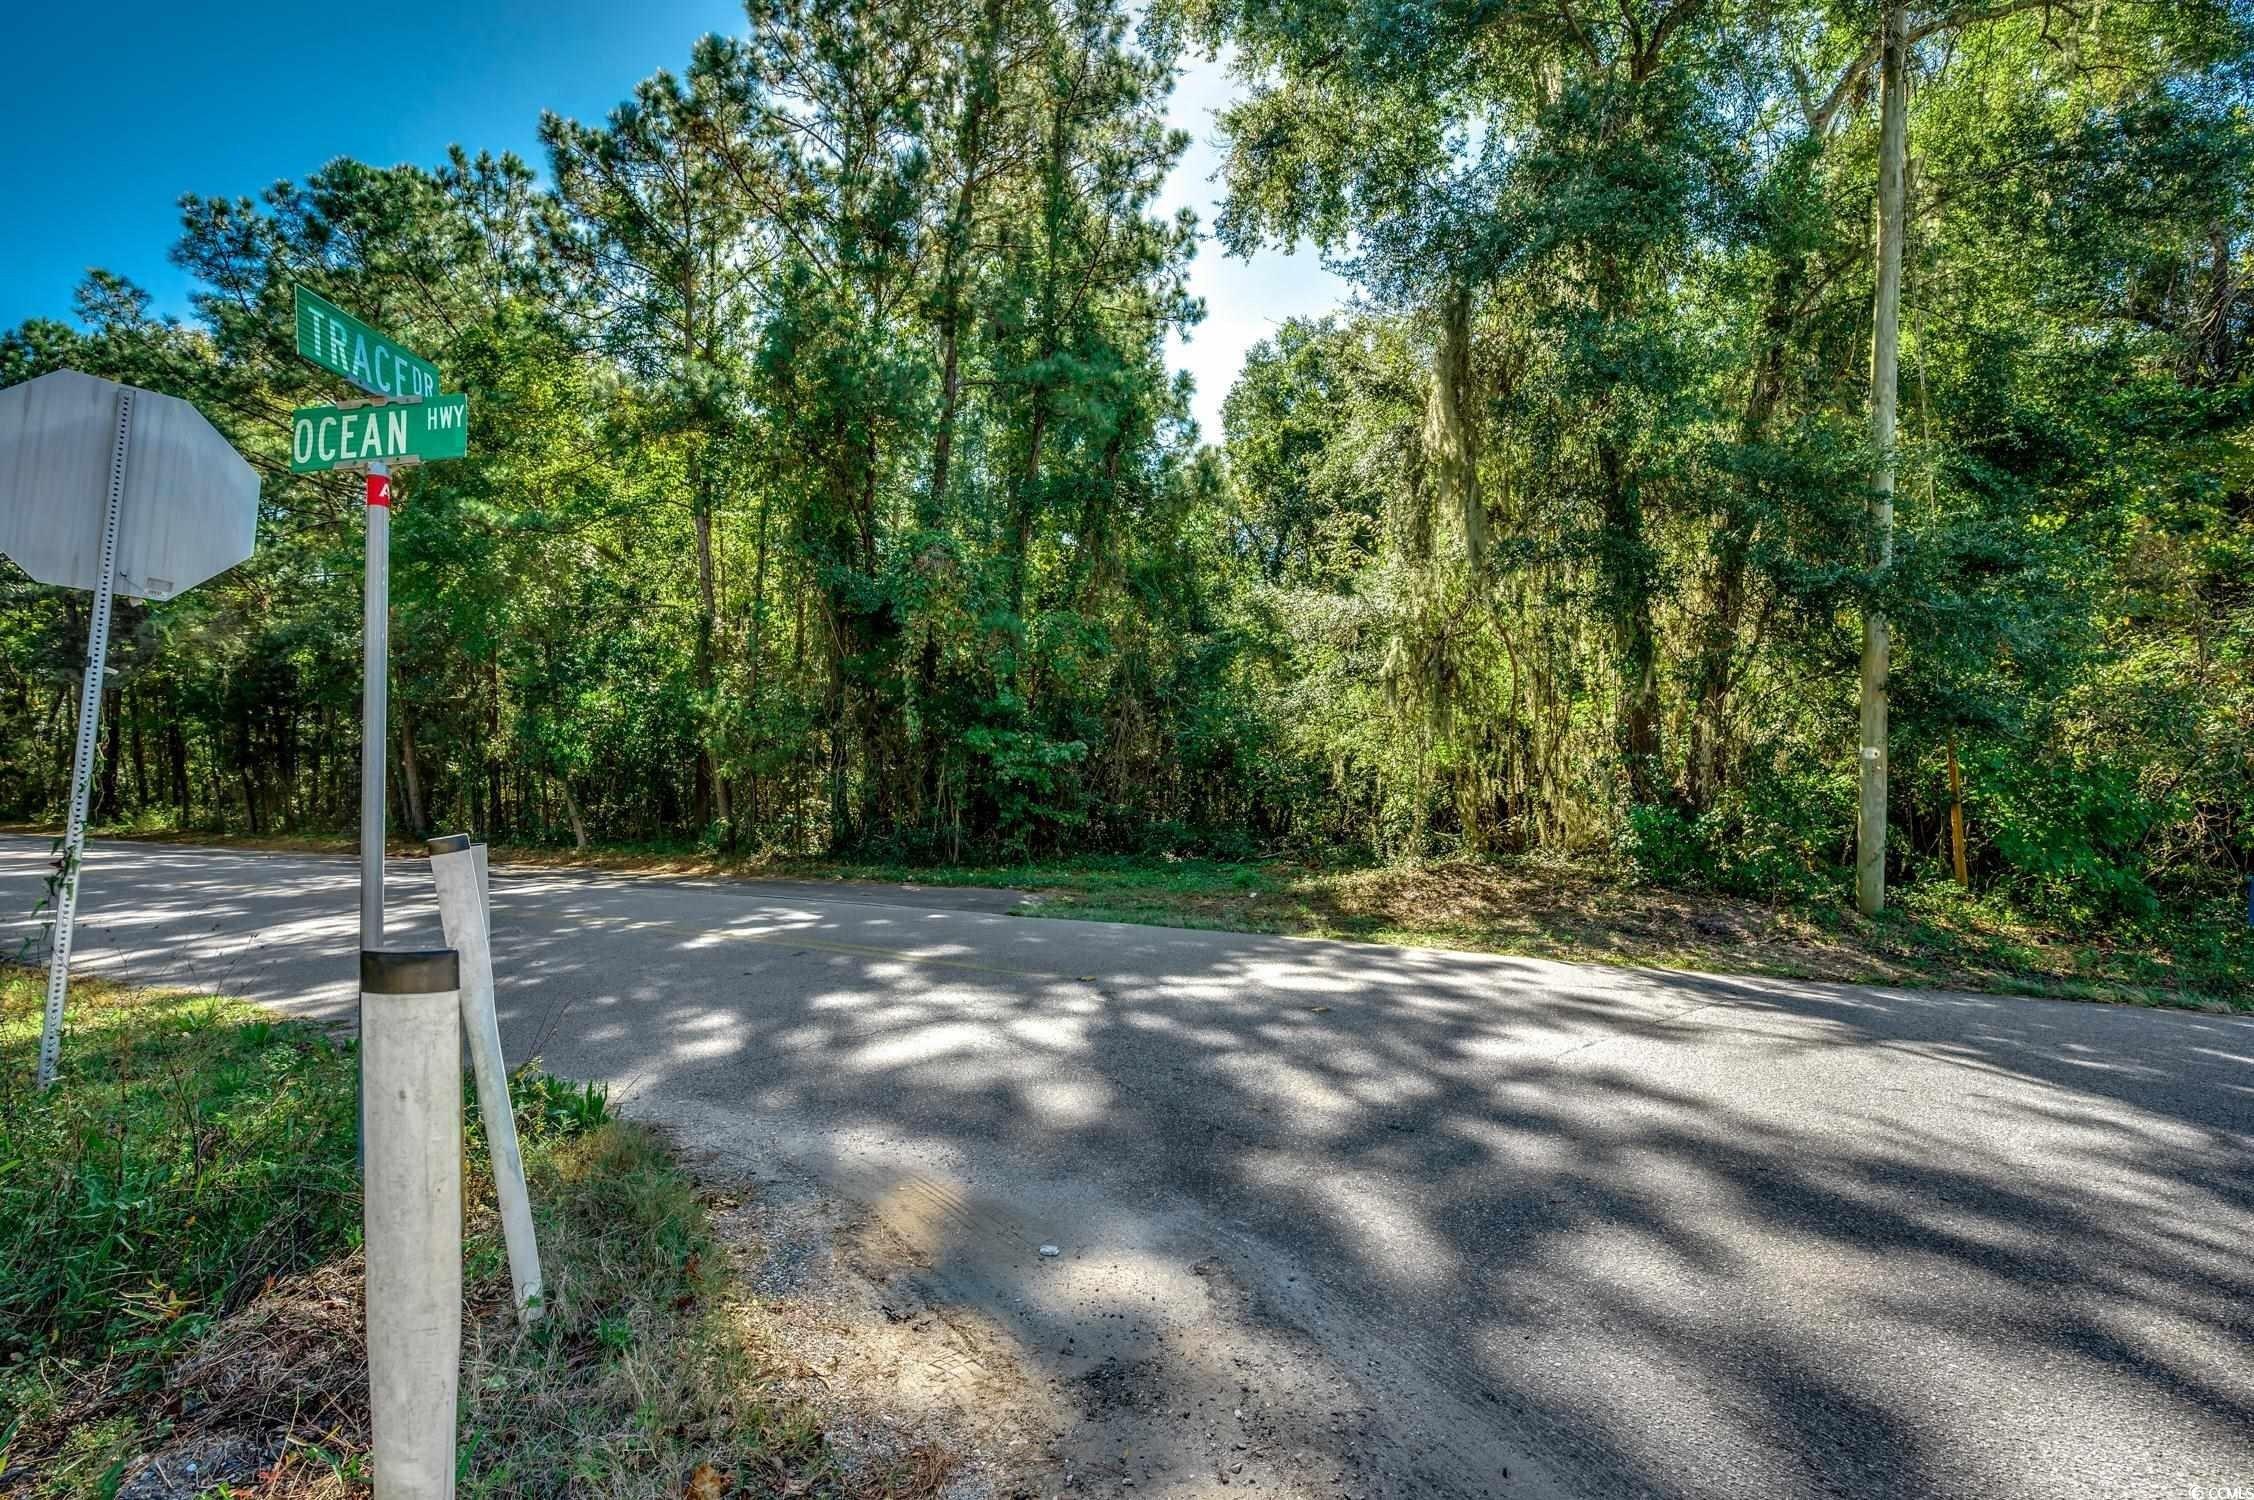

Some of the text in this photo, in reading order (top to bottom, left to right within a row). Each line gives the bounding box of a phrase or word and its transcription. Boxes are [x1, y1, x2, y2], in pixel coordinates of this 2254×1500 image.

[307, 306, 433, 397] TRACE DR
[293, 404, 464, 464] OCEAN HWY
